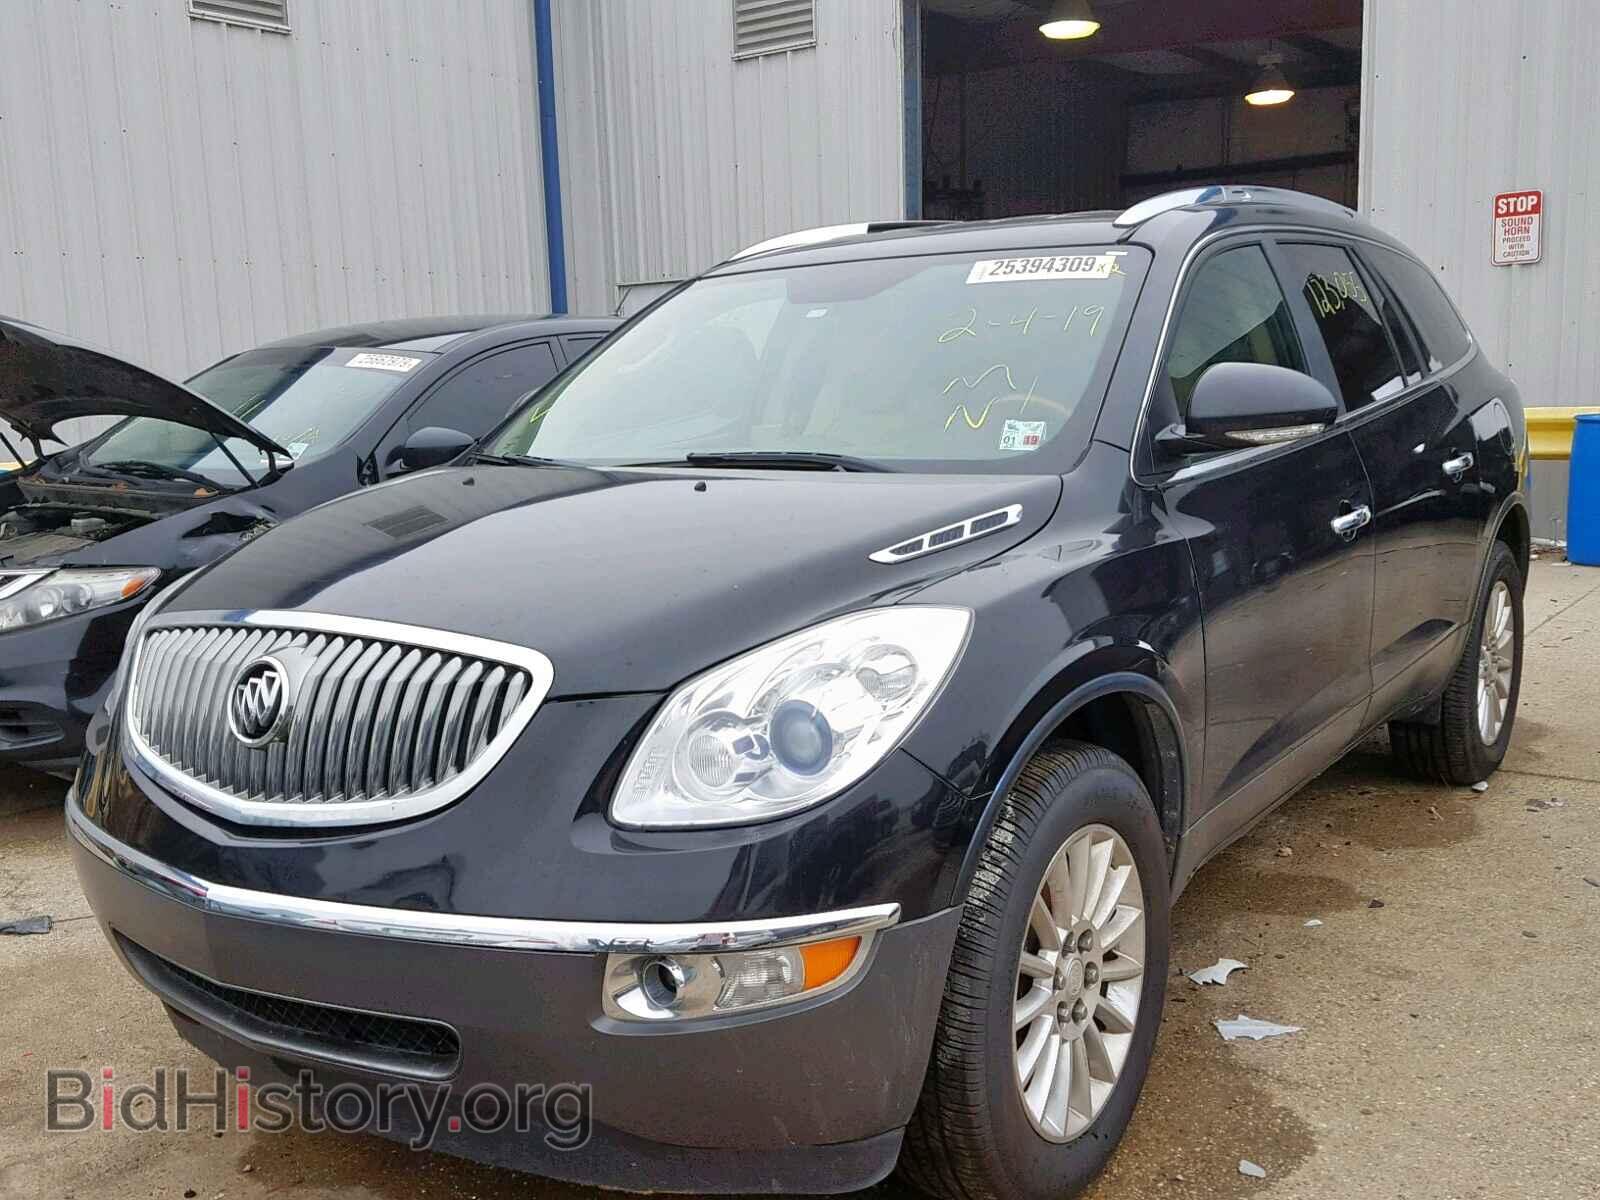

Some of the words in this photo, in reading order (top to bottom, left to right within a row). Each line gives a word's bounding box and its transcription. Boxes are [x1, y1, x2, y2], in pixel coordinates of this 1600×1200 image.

[1497, 195, 1538, 214] STOP
[1501, 216, 1534, 227] SOUND
[1504, 226, 1530, 236] HORN
[988, 257, 1097, 276] 25394309
